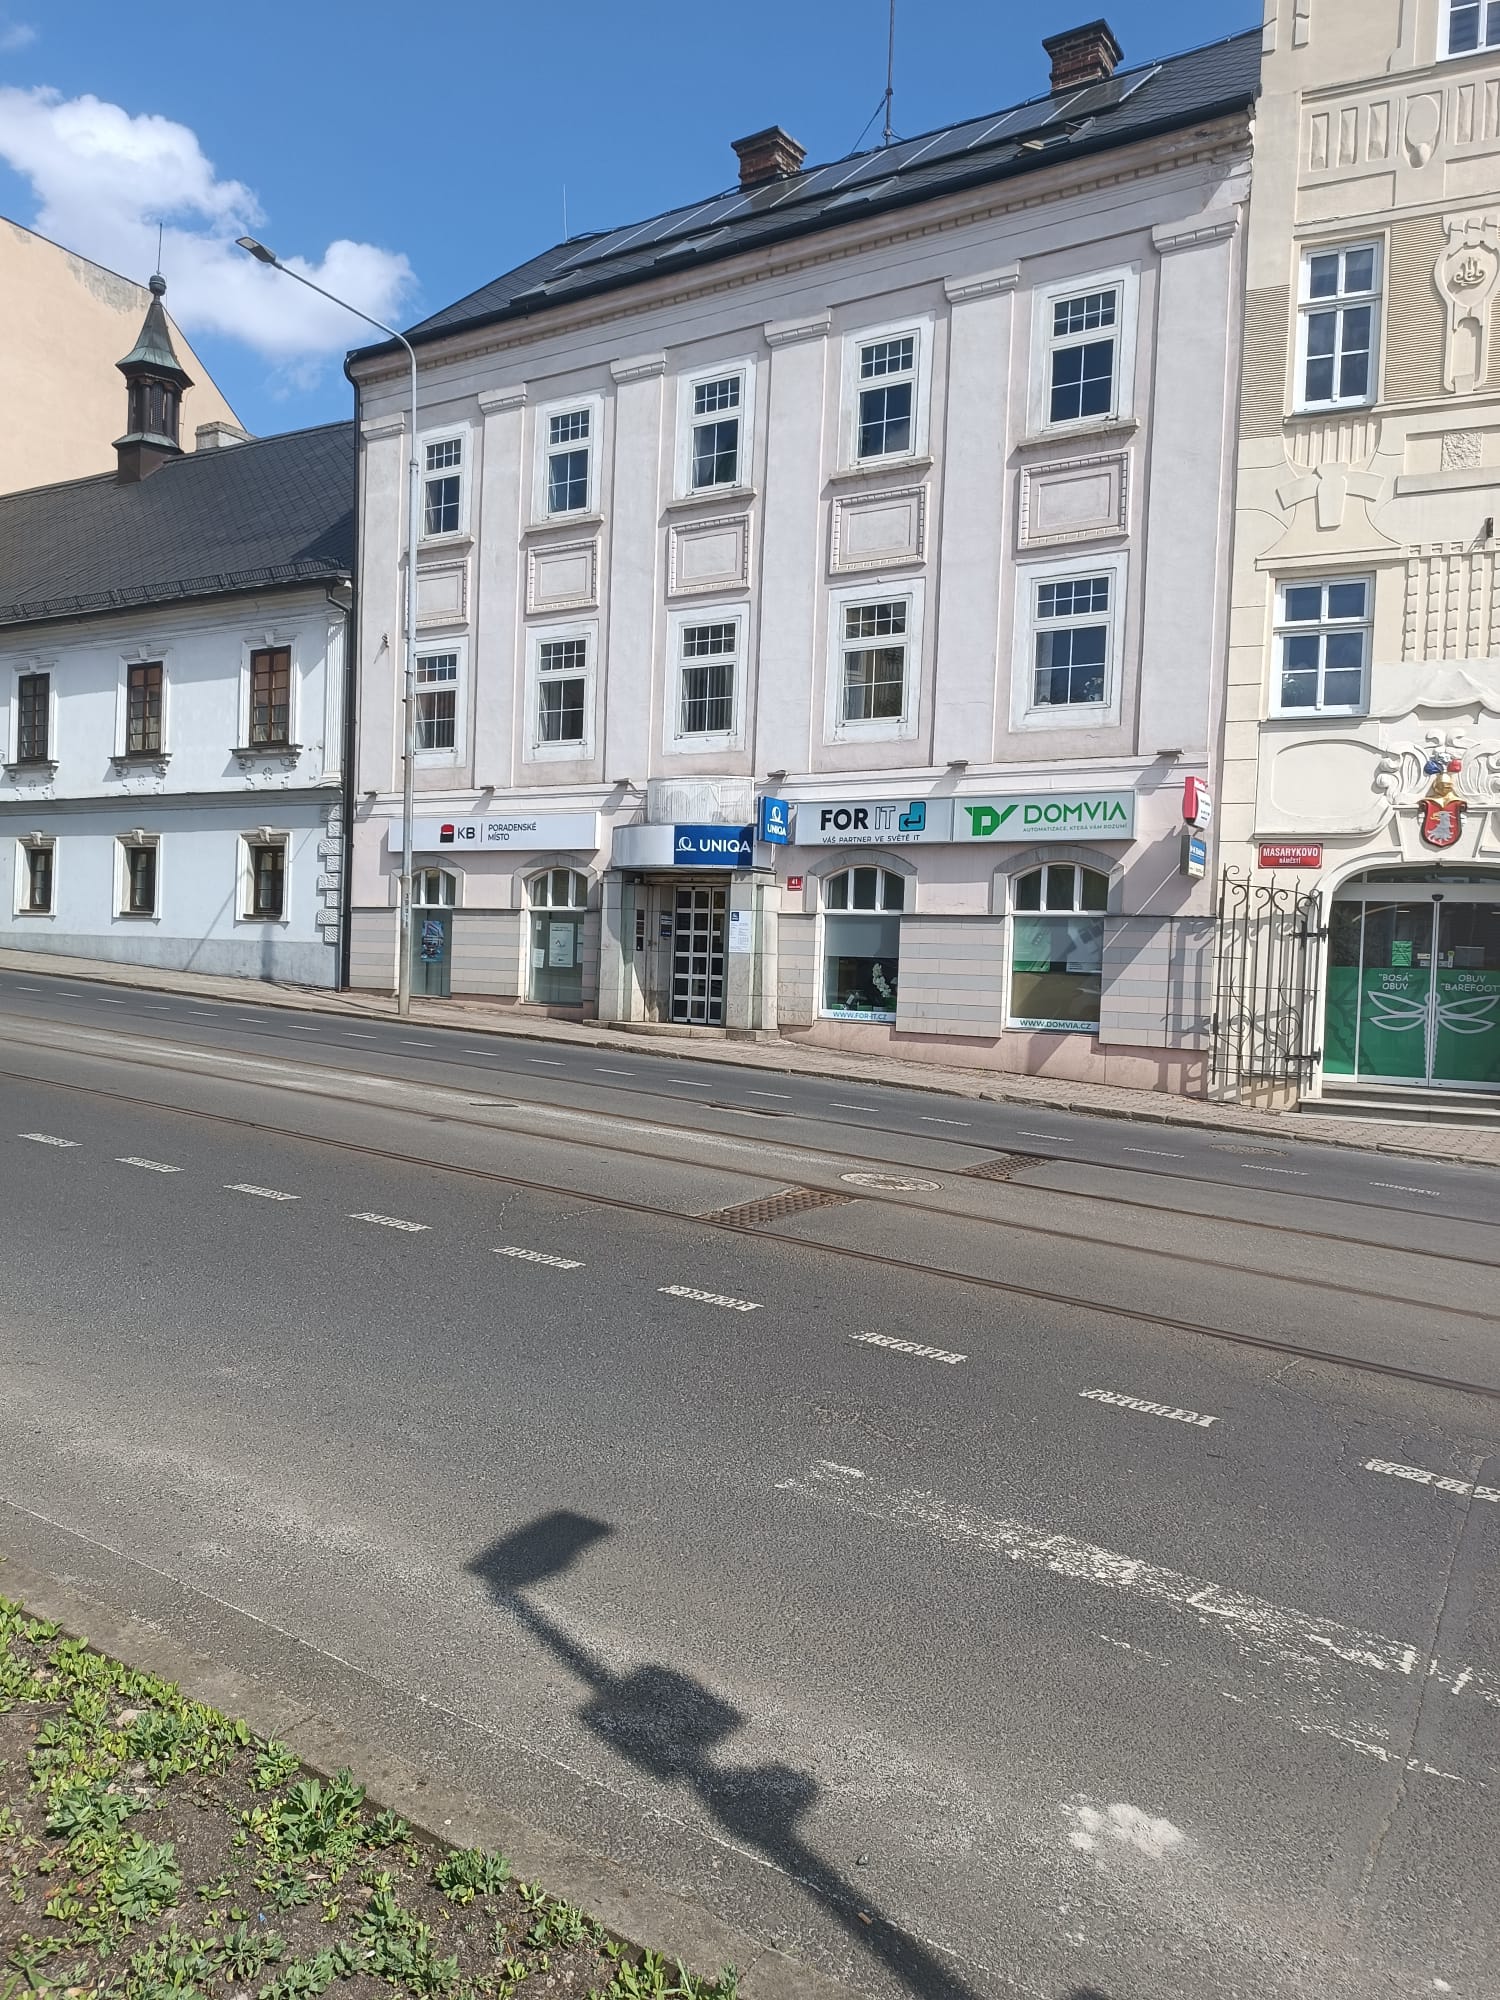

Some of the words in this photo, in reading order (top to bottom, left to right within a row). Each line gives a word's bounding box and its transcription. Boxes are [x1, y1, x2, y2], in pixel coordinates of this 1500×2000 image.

[1024, 801, 1127, 824] DOMVIA
[820, 808, 869, 831] FOR
[875, 806, 896, 830] IT
[488, 822, 537, 831] PORADENSKÉ
[767, 824, 787, 836] UNIQA
[457, 827, 475, 840] KB
[487, 832, 510, 841] MÍSTO
[822, 836, 836, 844] VÁŠ
[839, 835, 872, 843] PARTNER
[699, 839, 751, 853] UNIQA
[1263, 847, 1319, 857] MASARYKOVO
[1458, 974, 1486, 983] OBUV
[1382, 982, 1409, 990] OBUV
[1019, 1019, 1092, 1030] WWW.DOMVIA.CZ
